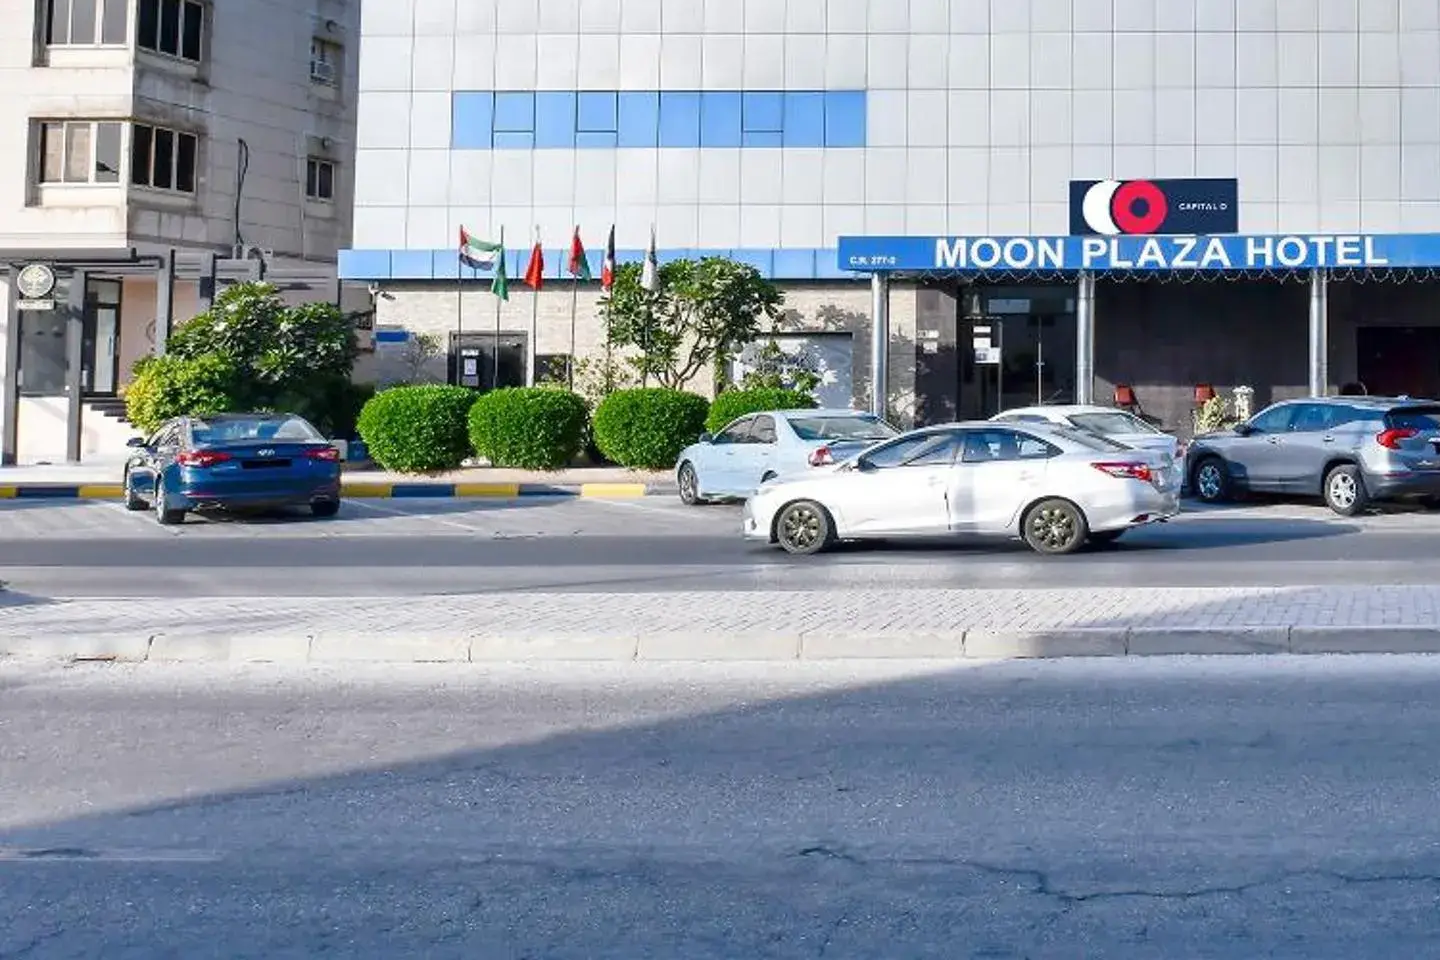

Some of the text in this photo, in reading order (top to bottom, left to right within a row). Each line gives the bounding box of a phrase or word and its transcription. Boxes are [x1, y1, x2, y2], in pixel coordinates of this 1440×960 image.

[1178, 202, 1218, 211] CAPITAL
[934, 235, 1389, 269] MOON PLAZA HOTEL
